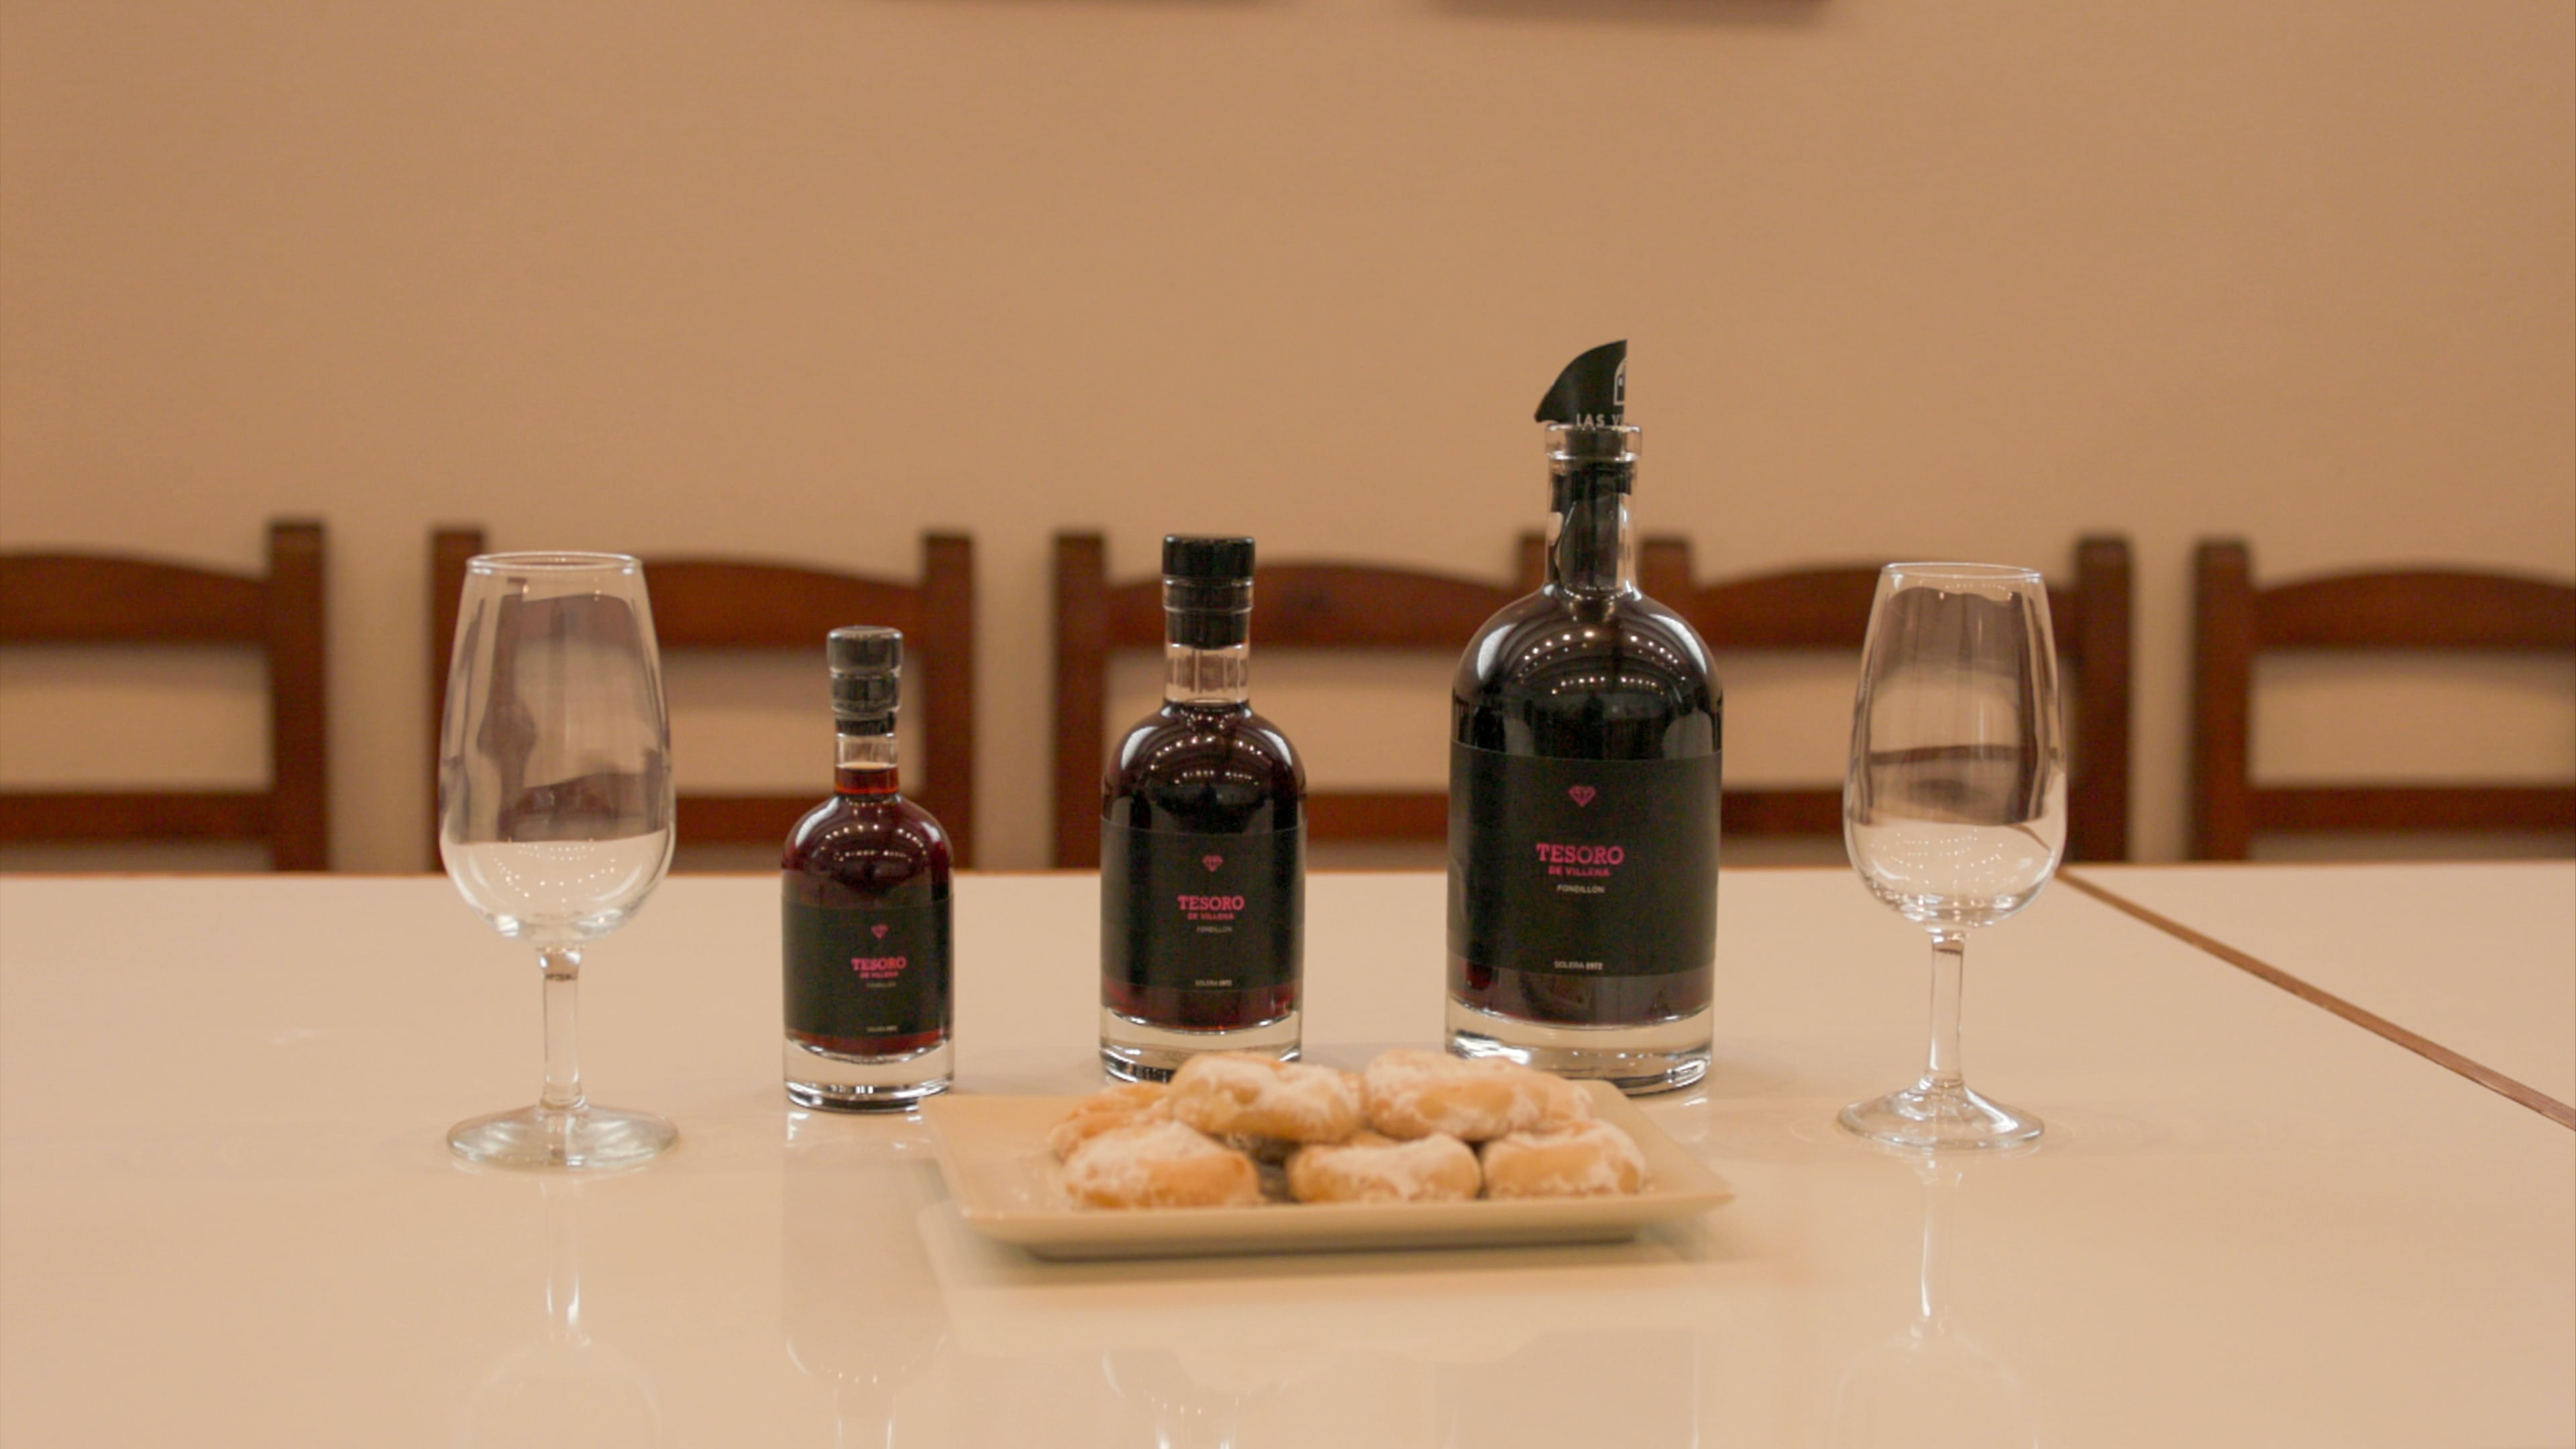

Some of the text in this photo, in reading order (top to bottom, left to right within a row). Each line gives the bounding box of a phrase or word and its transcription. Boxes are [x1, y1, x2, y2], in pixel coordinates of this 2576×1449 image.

[1576, 413, 1605, 427] LAS
[1536, 843, 1625, 865] TESORO
[1548, 865, 1610, 877] DE VILLENA
[1178, 895, 1245, 910] TESORO
[851, 957, 906, 971] TESORO
